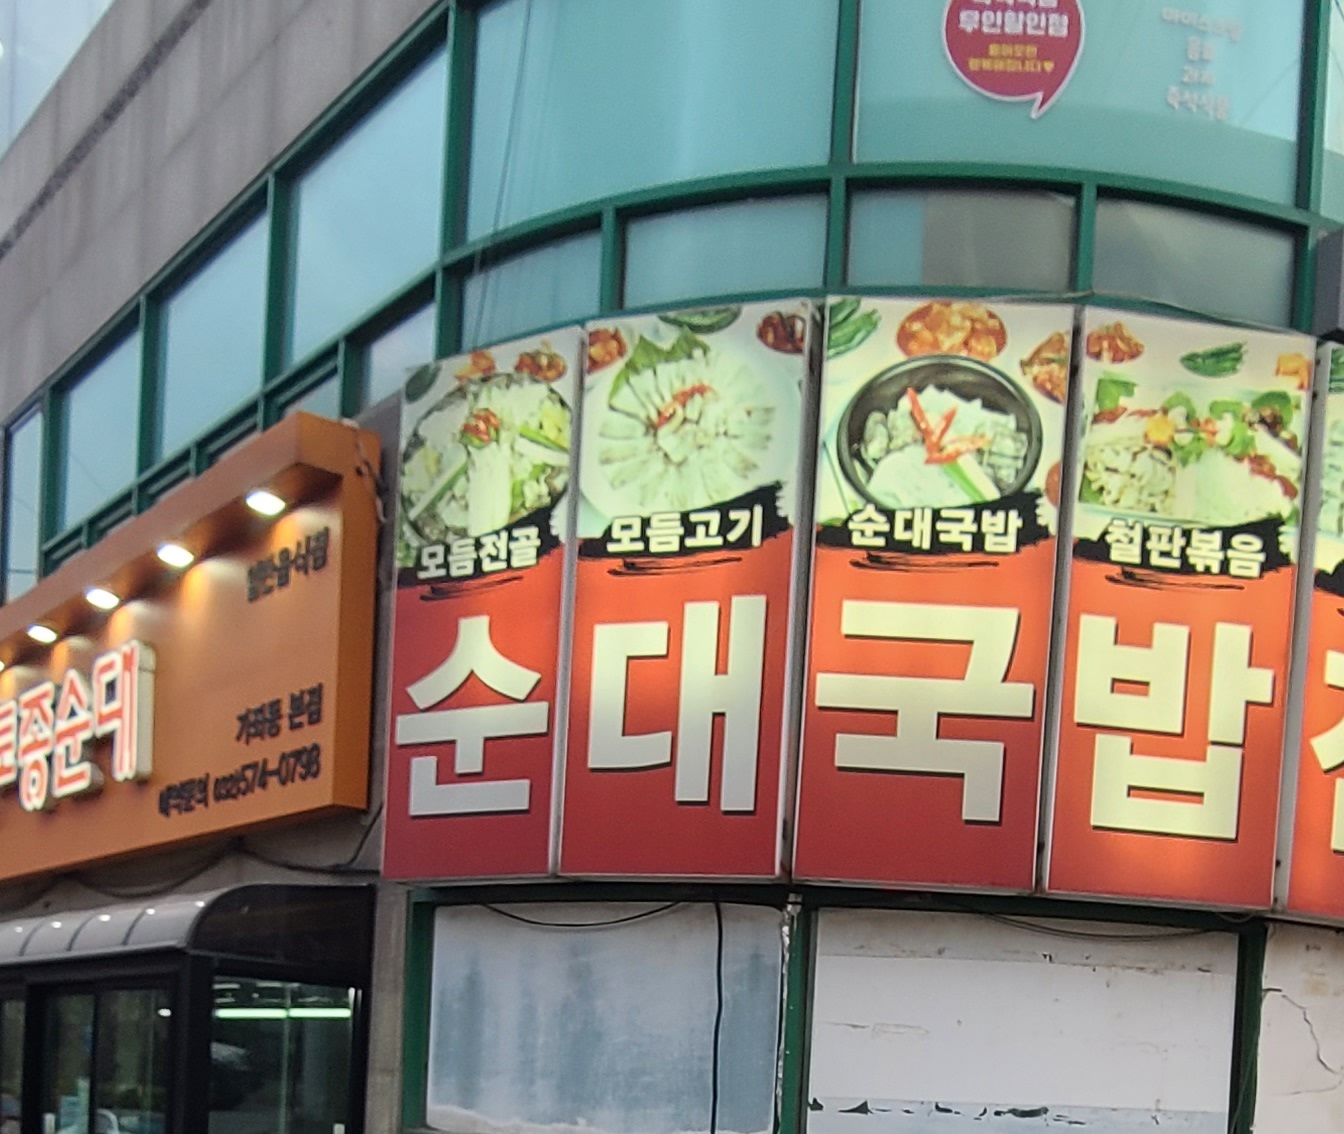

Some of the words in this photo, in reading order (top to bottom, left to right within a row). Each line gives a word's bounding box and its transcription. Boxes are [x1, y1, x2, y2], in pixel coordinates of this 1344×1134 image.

[417, 526, 541, 580] 모듬전골
[606, 504, 765, 555] 모듬고기
[847, 506, 1023, 553] 순대국밥
[1105, 518, 1267, 578] 철판볶음
[248, 526, 330, 603] 일반음식점
[288, 683, 325, 732] 본점
